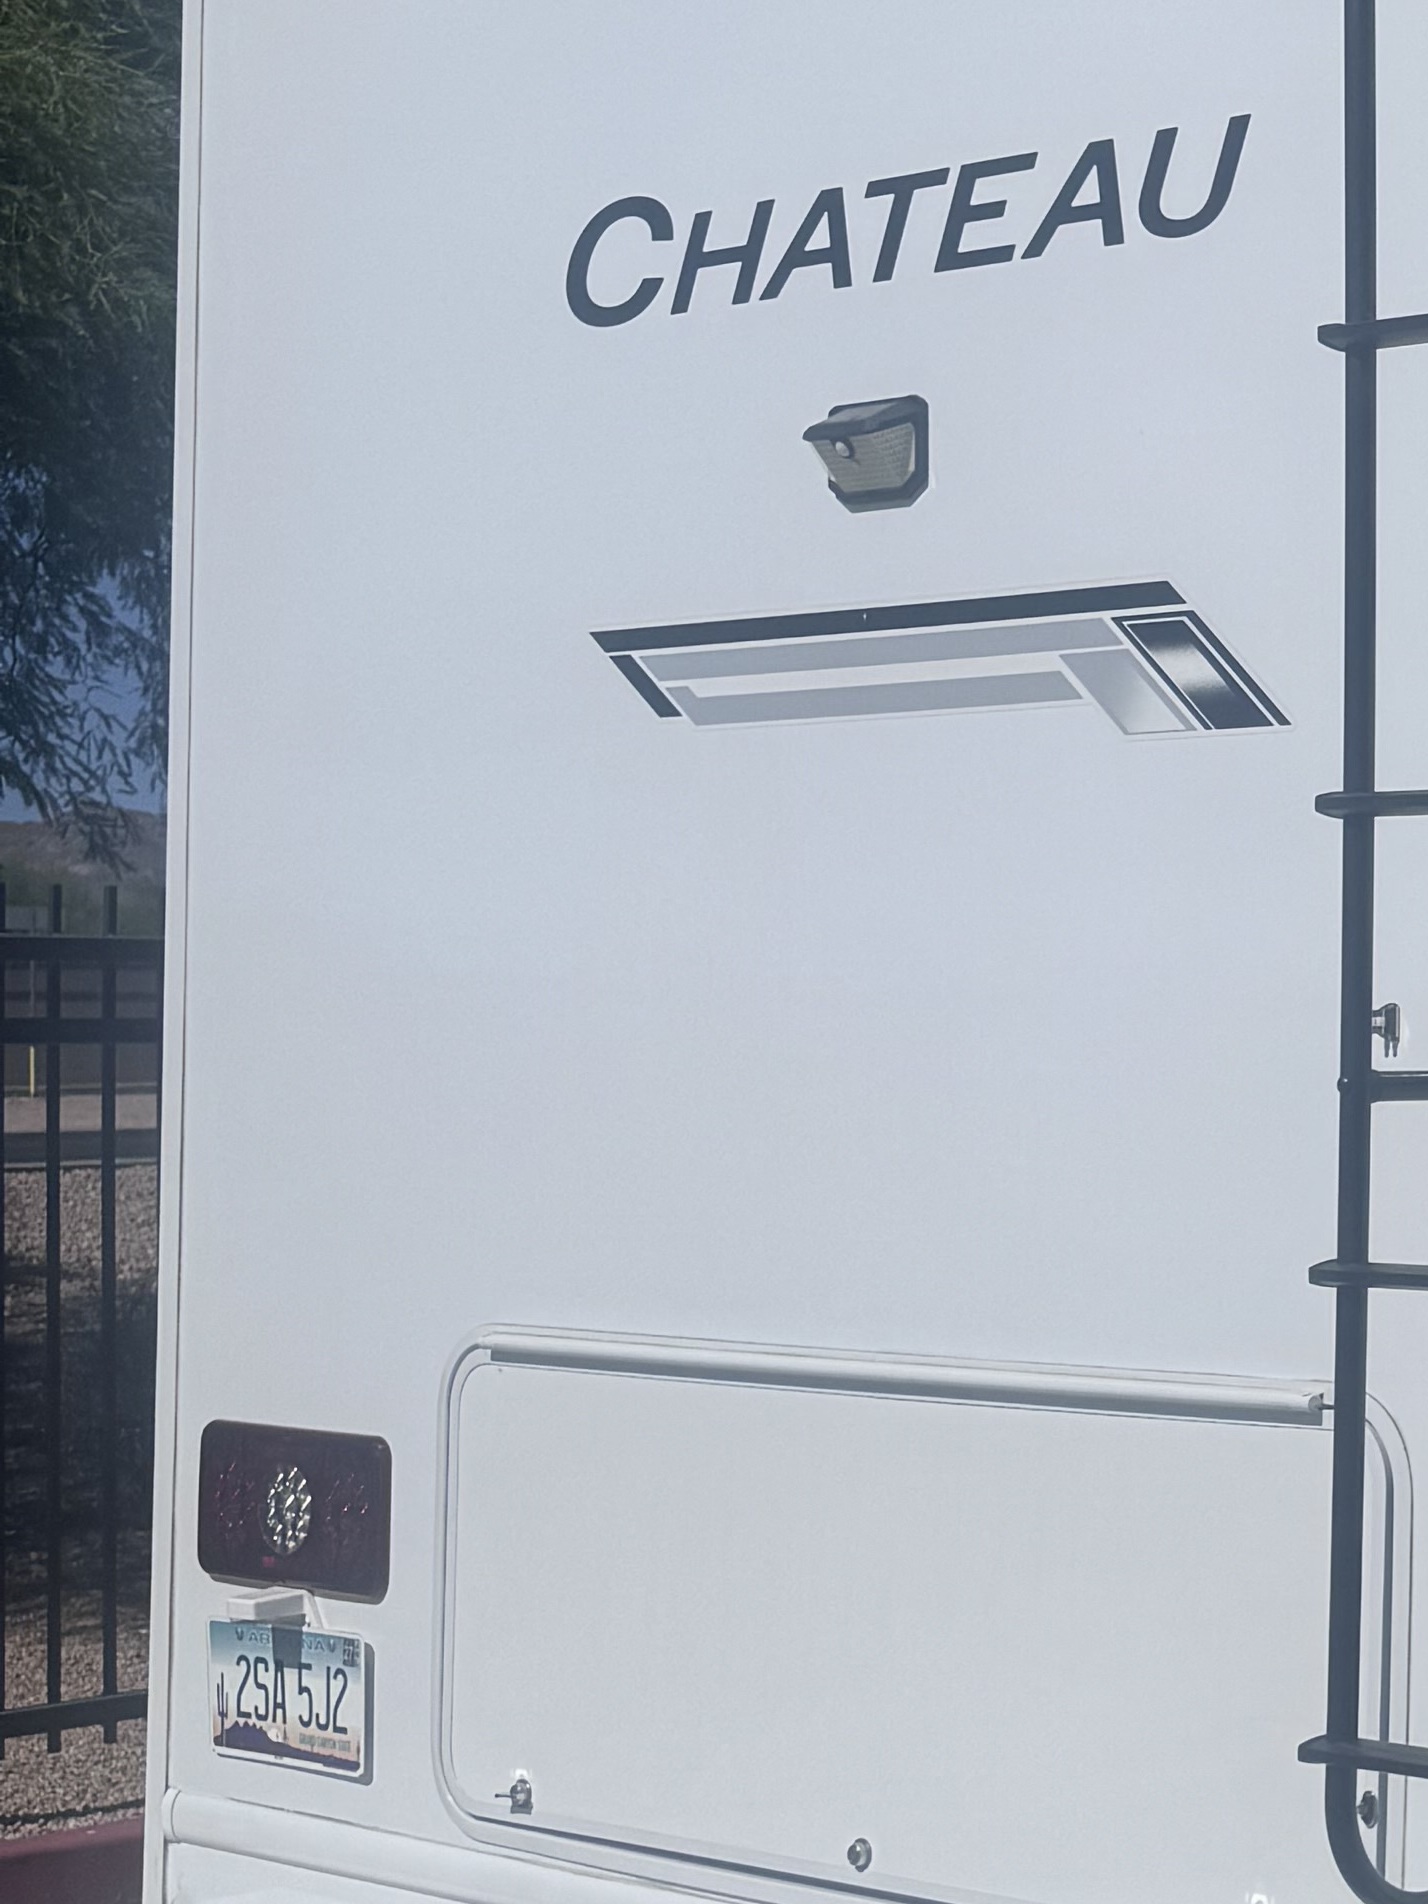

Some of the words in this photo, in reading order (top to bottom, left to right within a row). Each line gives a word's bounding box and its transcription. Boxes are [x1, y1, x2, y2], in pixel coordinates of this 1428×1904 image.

[566, 114, 1251, 327] CHATEAU
[248, 1631, 326, 1654] ARNA
[236, 1654, 287, 1725] 2SA
[298, 1662, 348, 1735] 5J2
